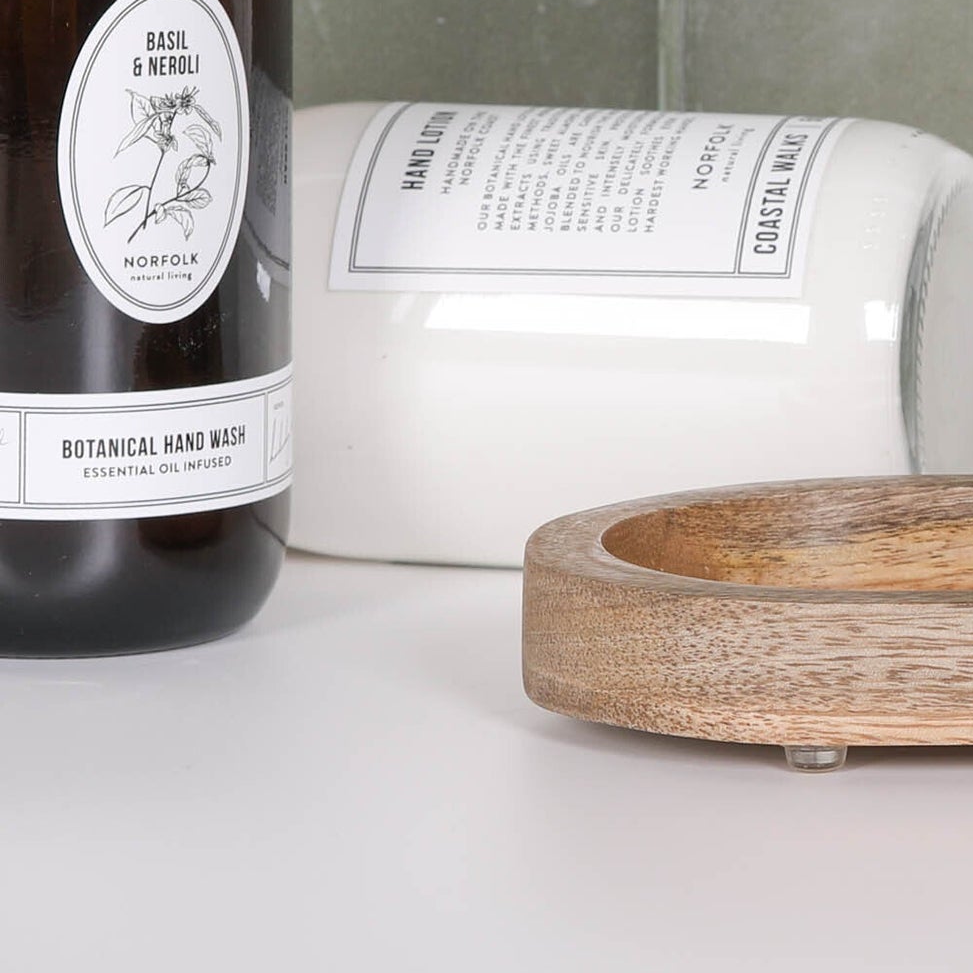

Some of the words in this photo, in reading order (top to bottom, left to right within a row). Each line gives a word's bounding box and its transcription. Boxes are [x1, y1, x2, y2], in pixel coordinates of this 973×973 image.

[132, 57, 143, 77] &
[148, 54, 200, 76] NEROLI
[146, 30, 189, 51] BASIL
[418, 111, 457, 144] LOTION
[544, 138, 562, 165] SWEET
[770, 133, 808, 172] WALKS
[402, 149, 435, 190] HAND
[441, 133, 471, 193] HANDMADE
[458, 137, 485, 185] NORFOLK
[692, 123, 734, 189] NORFOLK
[722, 149, 738, 182] natural
[477, 203, 492, 230] OUR
[485, 143, 510, 199] BOTANICAL
[494, 195, 509, 230] MADE
[503, 163, 519, 189] WITH
[512, 143, 526, 158] THE
[511, 173, 532, 230] EXTRACTS
[528, 137, 546, 164] USING
[544, 186, 562, 231] JOJOBA
[558, 154, 571, 175] OILS
[561, 177, 582, 231] BLENDED
[574, 161, 586, 173] TO
[577, 173, 600, 231] SENSITIVE
[594, 205, 607, 232] AND
[602, 146, 624, 197] INTENSELY
[611, 206, 624, 232] OUR
[620, 141, 643, 194] DELICATELY
[627, 188, 646, 232] LOTION
[641, 136, 664, 175] SOOTHES
[645, 180, 664, 232] HARDEST
[753, 178, 790, 255] COASTAL
[124, 253, 199, 268] NORFOLK
[130, 270, 165, 281] natural
[168, 270, 193, 282] living
[62, 436, 158, 459] BOTANICAL
[164, 430, 205, 454] HAND
[209, 424, 246, 449] WASH
[83, 465, 155, 478] ESSENTIAL
[159, 462, 180, 473] OIL
[184, 455, 232, 472] INFUSED
